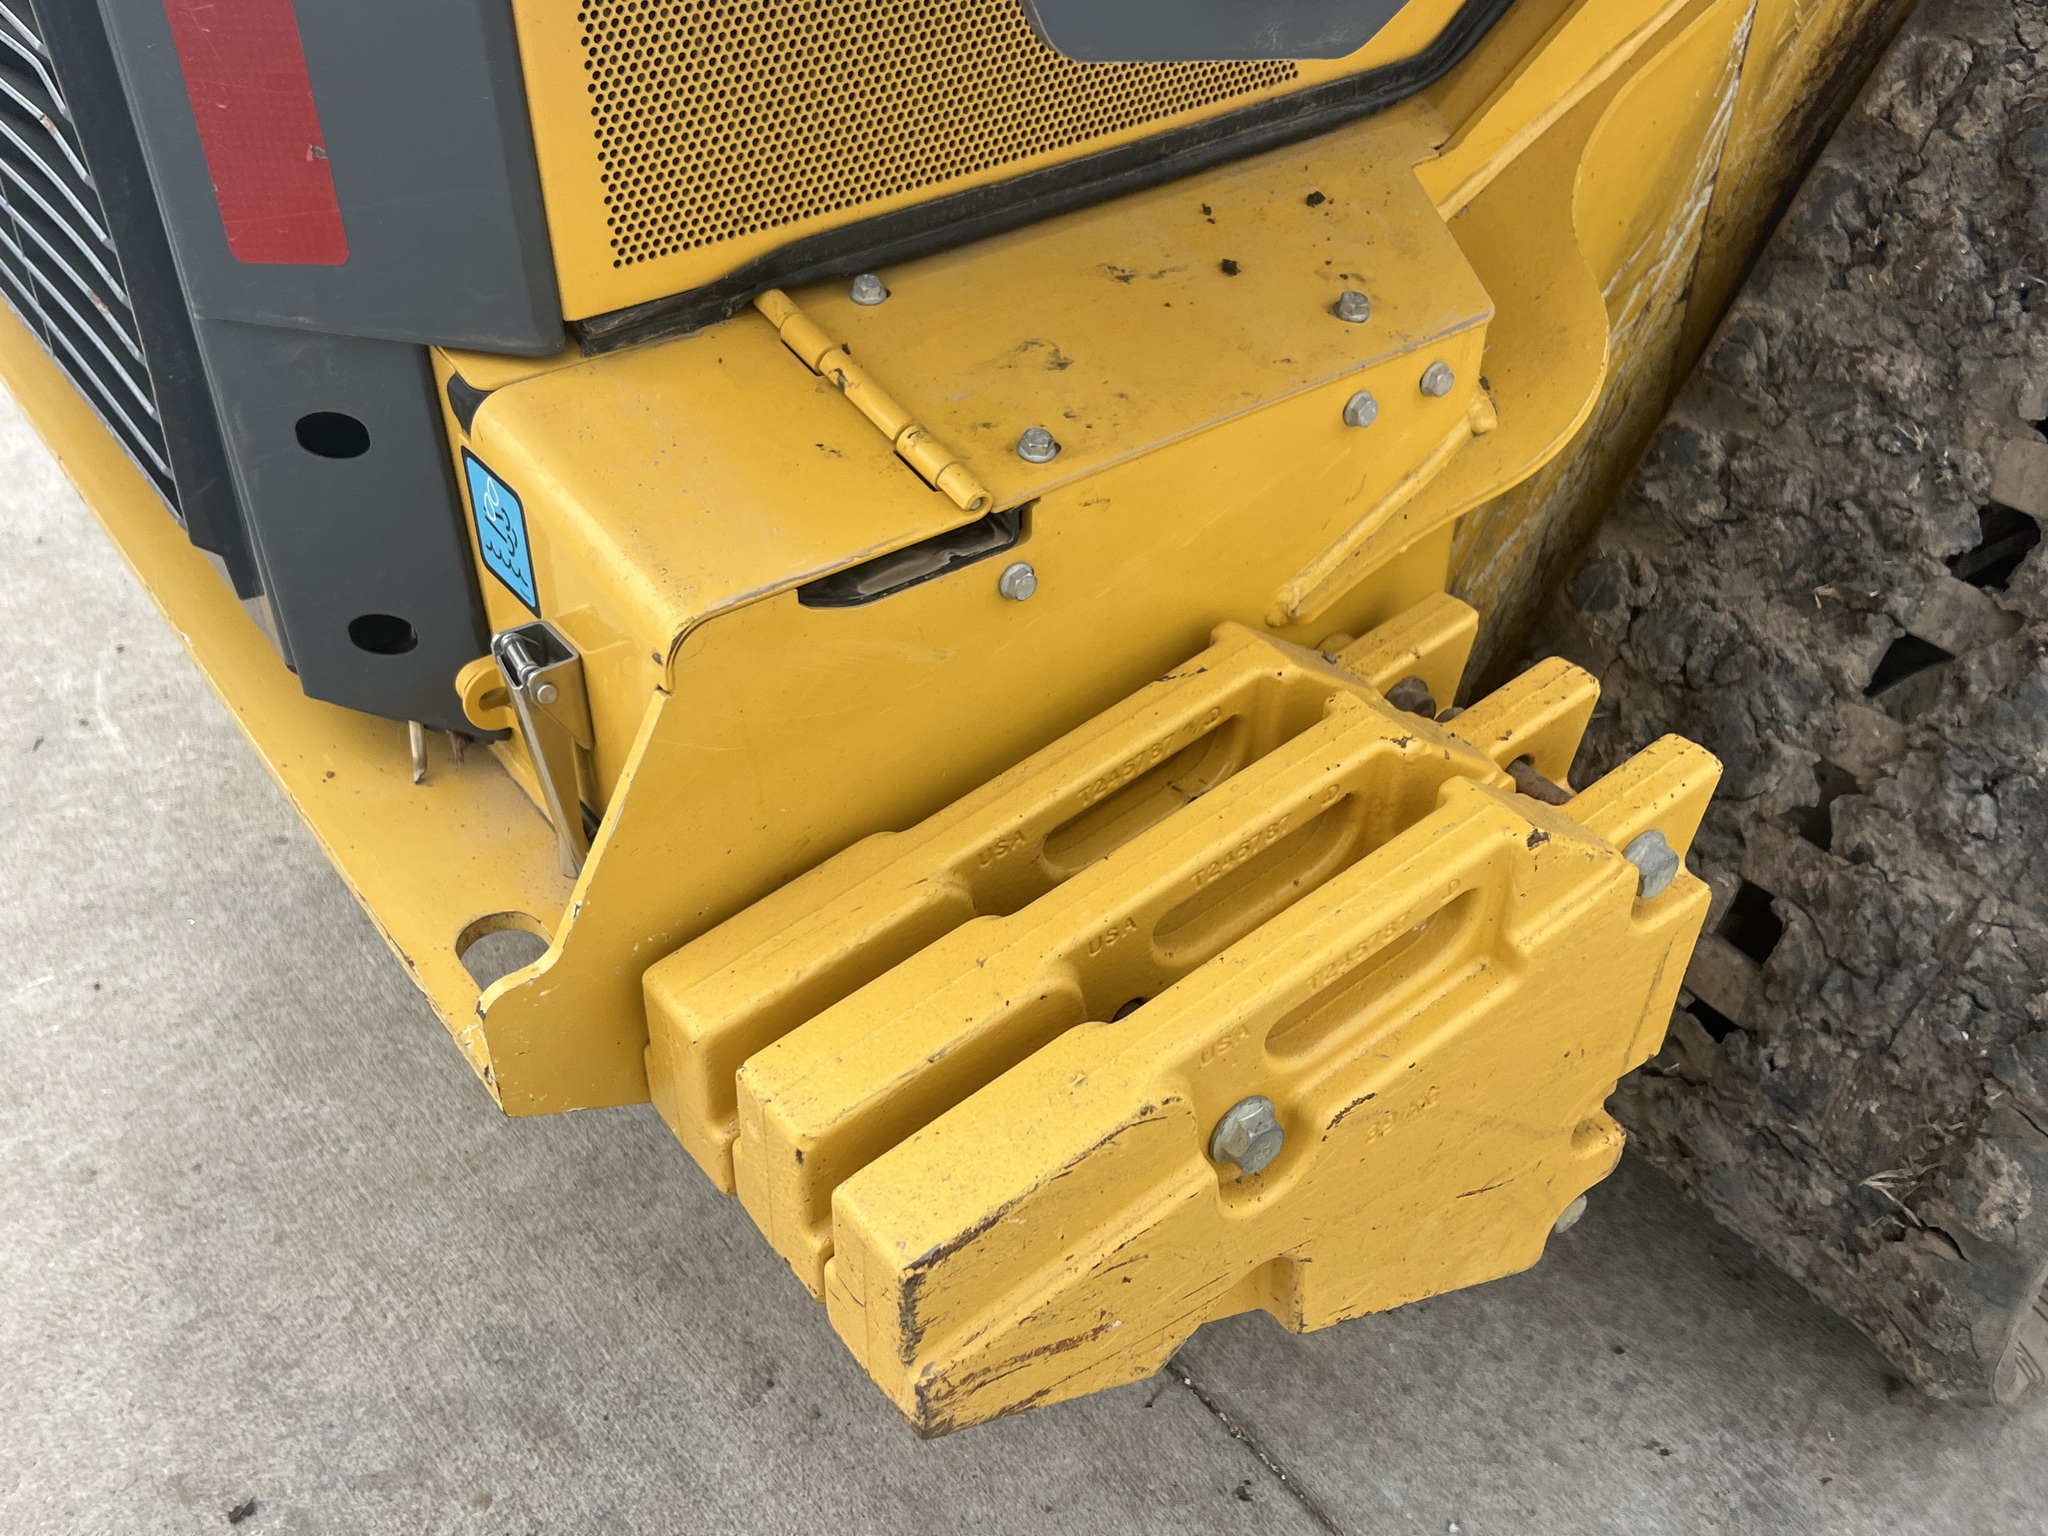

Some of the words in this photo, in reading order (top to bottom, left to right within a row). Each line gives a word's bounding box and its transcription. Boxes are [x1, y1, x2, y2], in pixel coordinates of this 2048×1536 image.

[978, 830, 1026, 869] USA
[1088, 915, 1138, 957] USA
[1199, 1023, 1251, 1067] USA
